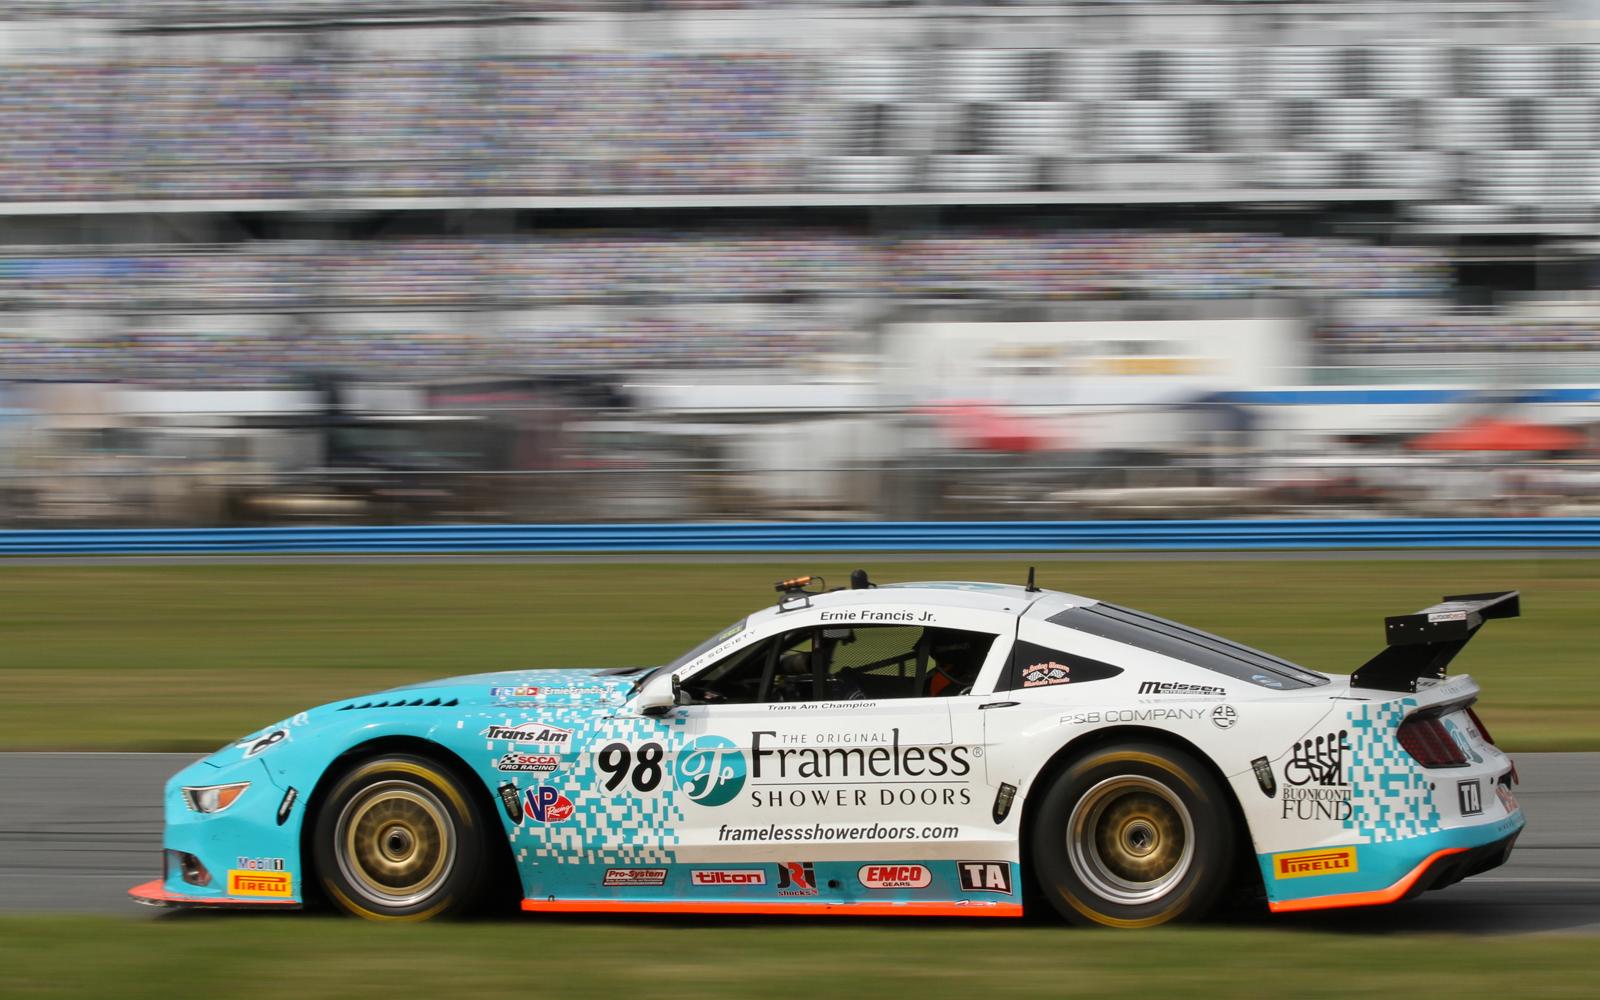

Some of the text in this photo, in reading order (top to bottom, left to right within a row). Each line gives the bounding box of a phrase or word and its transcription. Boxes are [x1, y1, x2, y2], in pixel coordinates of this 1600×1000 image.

[820, 611, 937, 622] Ernie Francis Jr.
[1138, 681, 1225, 694] Meissen
[800, 704, 819, 712] Am
[822, 702, 877, 712] Champion
[1105, 708, 1206, 723] COMPANY
[487, 726, 568, 742] Trans Am
[782, 733, 888, 744] THE ORIGINAL
[518, 756, 557, 764] SCCA
[752, 728, 971, 778] Frameless
[598, 742, 664, 792] 98
[752, 787, 971, 807] SHOWER DOORS
[1283, 788, 1352, 801] BUONICONTI
[1461, 784, 1479, 812] TA
[526, 787, 558, 821] VP
[1281, 800, 1353, 821] FUND
[718, 823, 959, 841] framelessshowerdoors.com
[1280, 852, 1350, 874] PIRELLI
[609, 870, 664, 878] Pro-System
[696, 871, 762, 883] tilton
[866, 866, 922, 881] EMCO
[965, 864, 1007, 889] TA
[234, 875, 287, 892] PIRELLI
